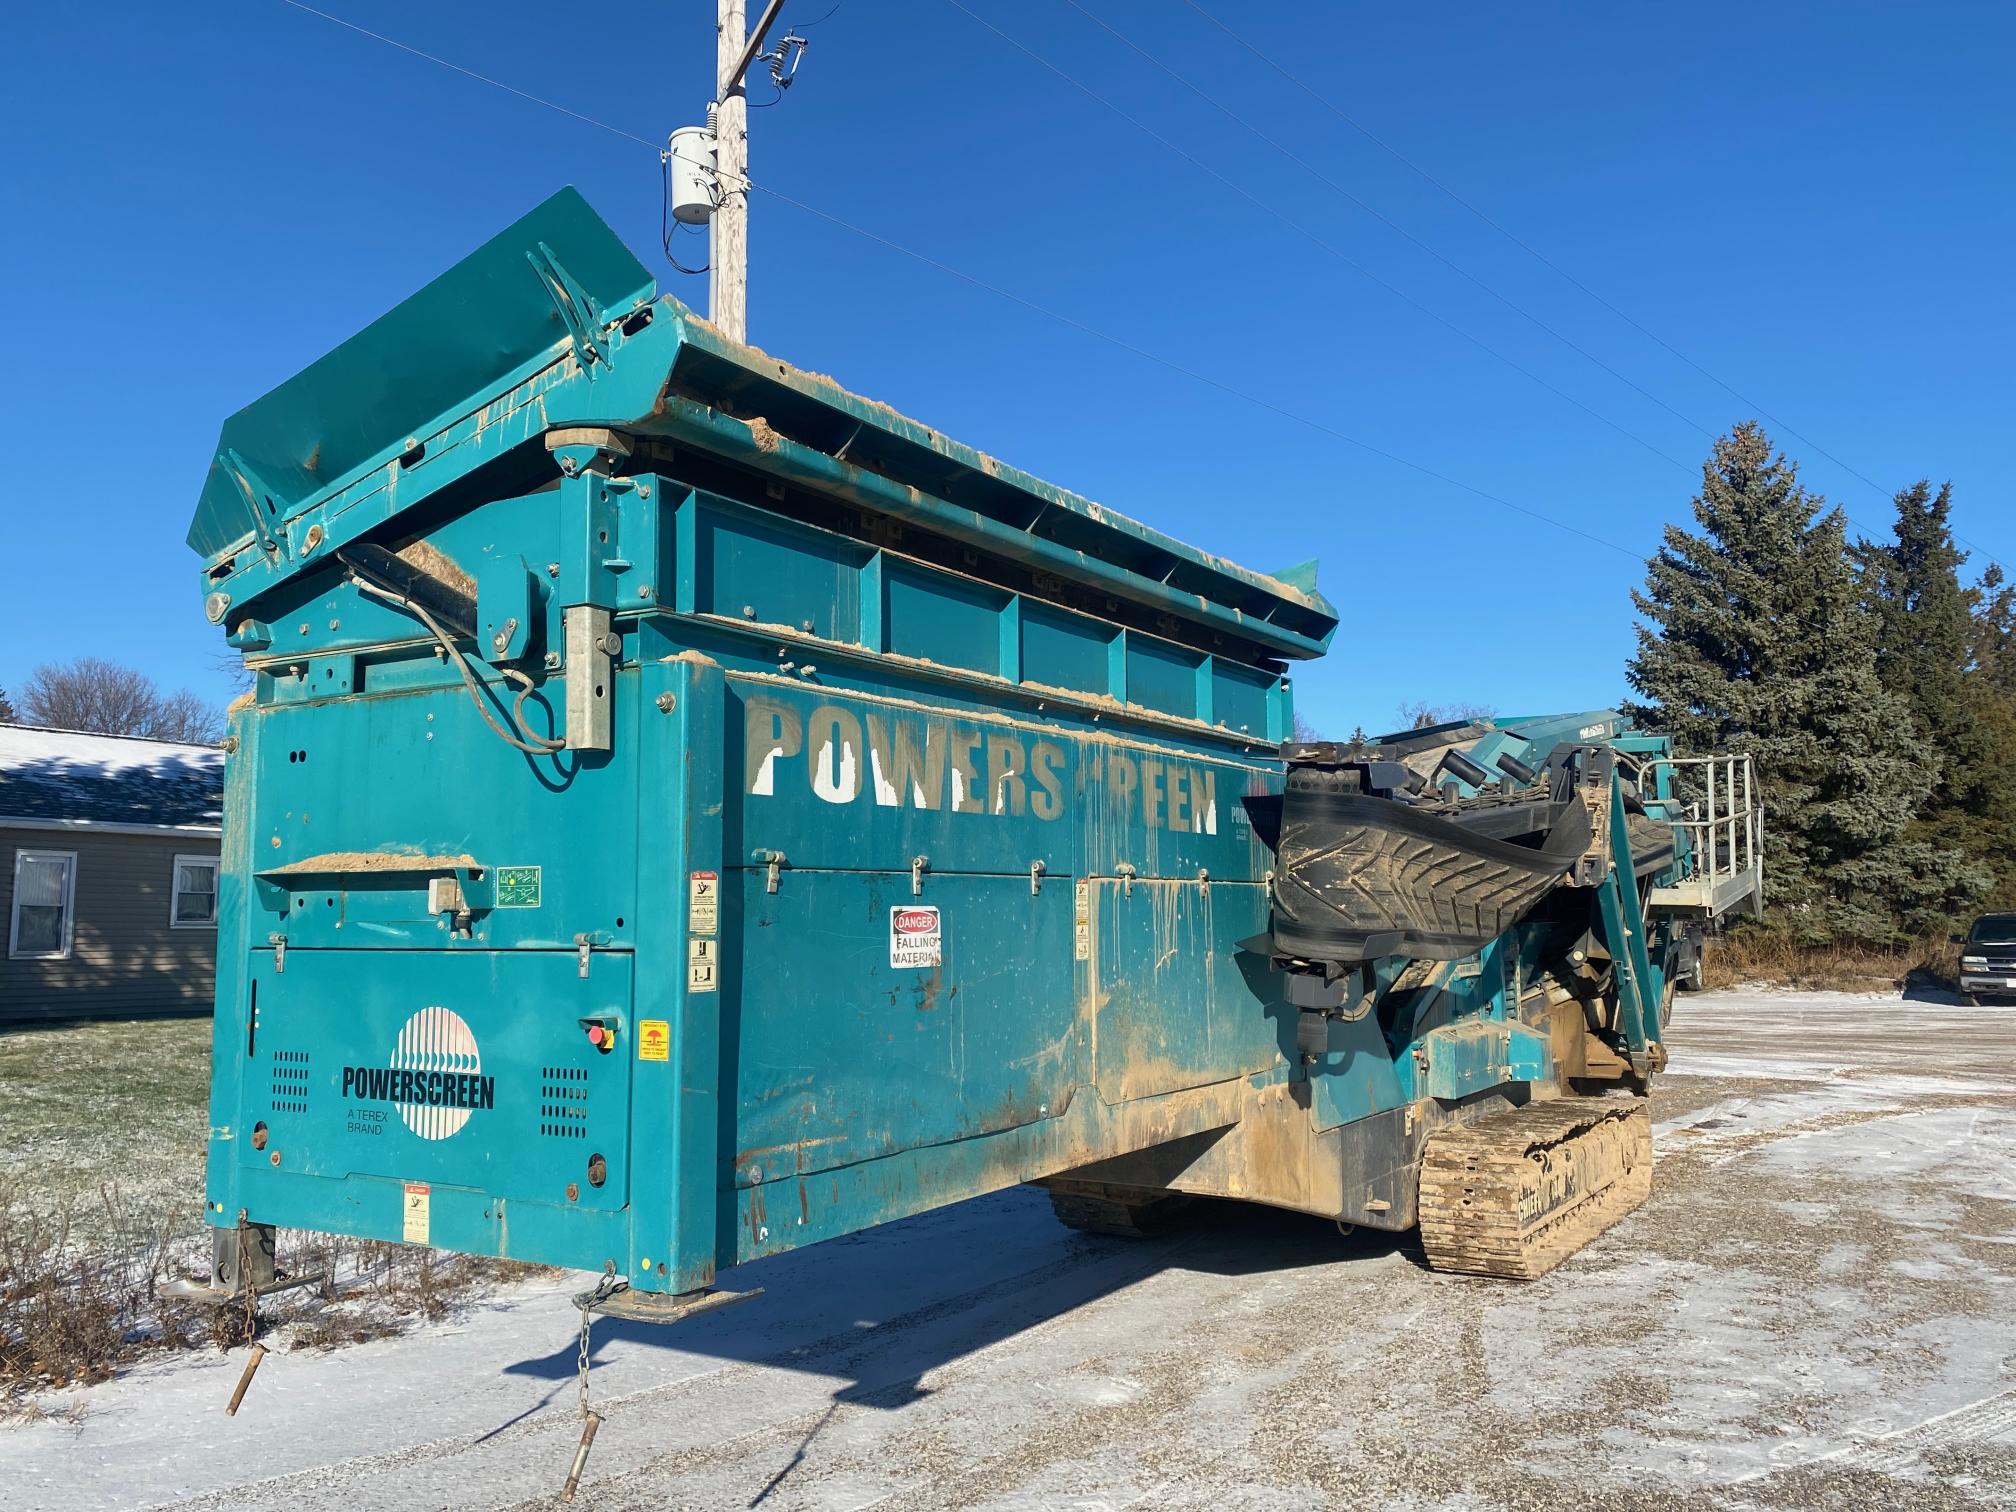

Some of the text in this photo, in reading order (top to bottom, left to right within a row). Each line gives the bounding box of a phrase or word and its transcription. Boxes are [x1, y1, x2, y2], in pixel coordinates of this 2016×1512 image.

[898, 916, 933, 929] DANGER
[896, 936, 936, 949] FALLING
[342, 1066, 495, 1110] POWERSCREEN
[347, 1109, 388, 1123] A TEREX
[347, 1123, 382, 1136] BRAND
